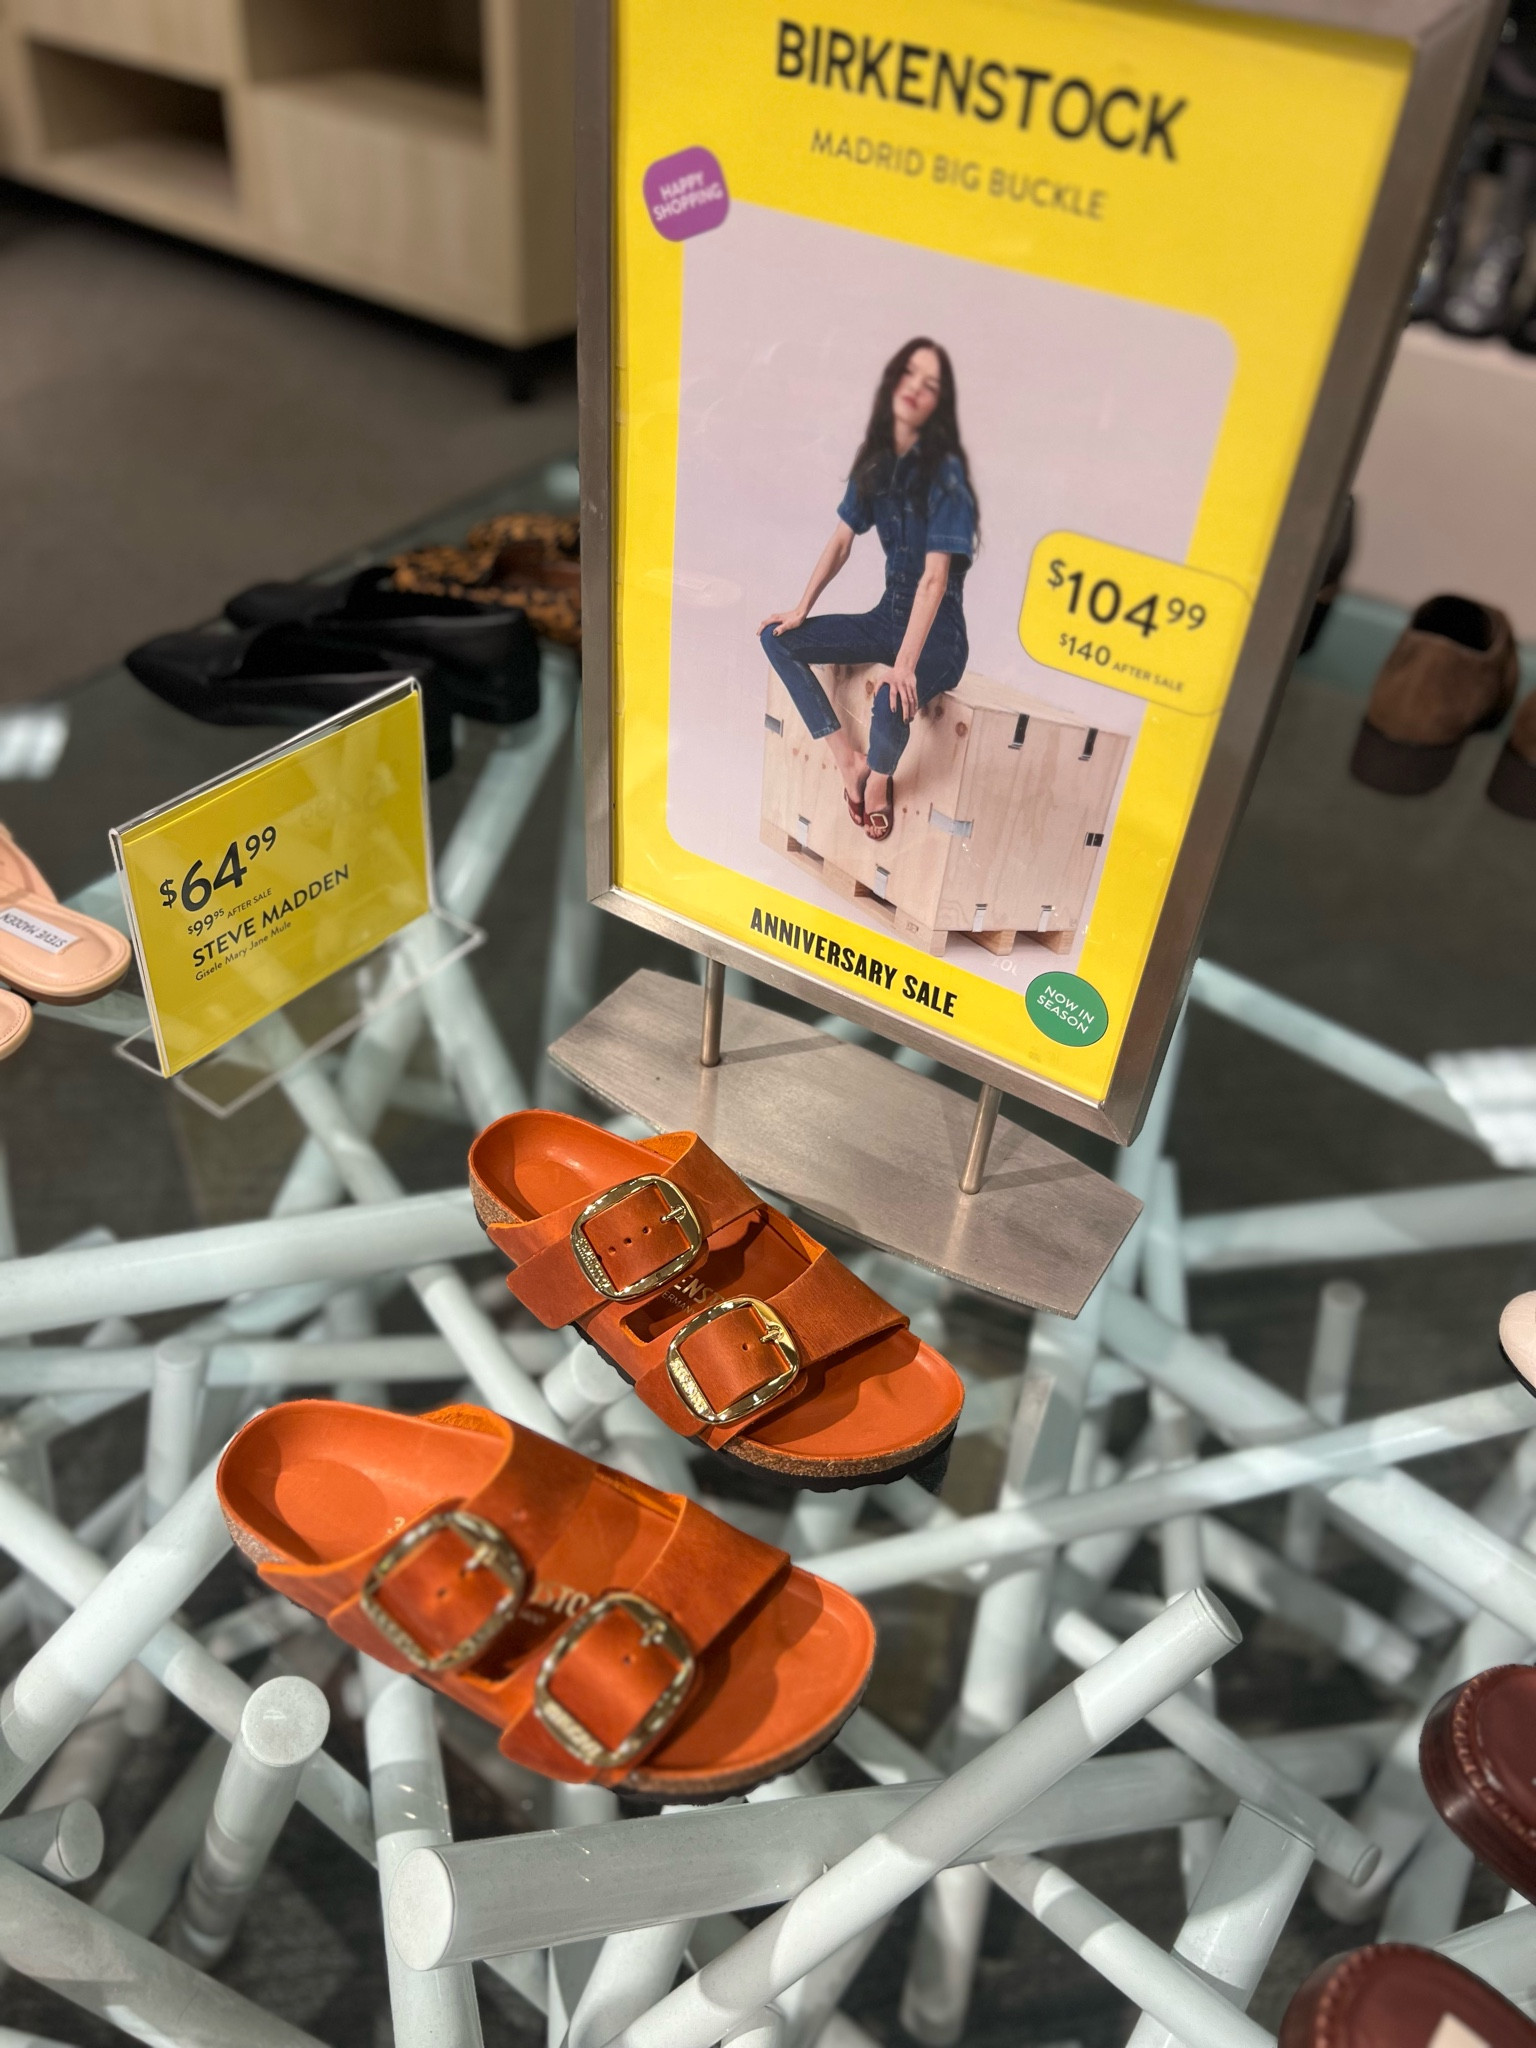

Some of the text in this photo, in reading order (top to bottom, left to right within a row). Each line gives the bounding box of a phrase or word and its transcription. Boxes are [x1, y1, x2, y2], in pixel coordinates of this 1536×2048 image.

[776, 19, 1189, 162] BIRKENSTOCK
[660, 171, 703, 201] HAPPY
[810, 129, 1109, 221] MADRID BIG BUCKLE
[653, 181, 723, 221] SHOPPING
[1058, 632, 1184, 693] $140 AFTER SALE
[192, 863, 350, 968] STEVE MADDEN
[227, 899, 252, 919] AFTER
[253, 887, 273, 904] SALE
[35, 930, 68, 948] STEVE
[195, 920, 292, 981] Gisele Mary Jane Mule
[750, 907, 958, 1019] ANNIVERSARY SALE
[1037, 994, 1089, 1034] SEASON
[1044, 985, 1095, 1024] NOW IN
